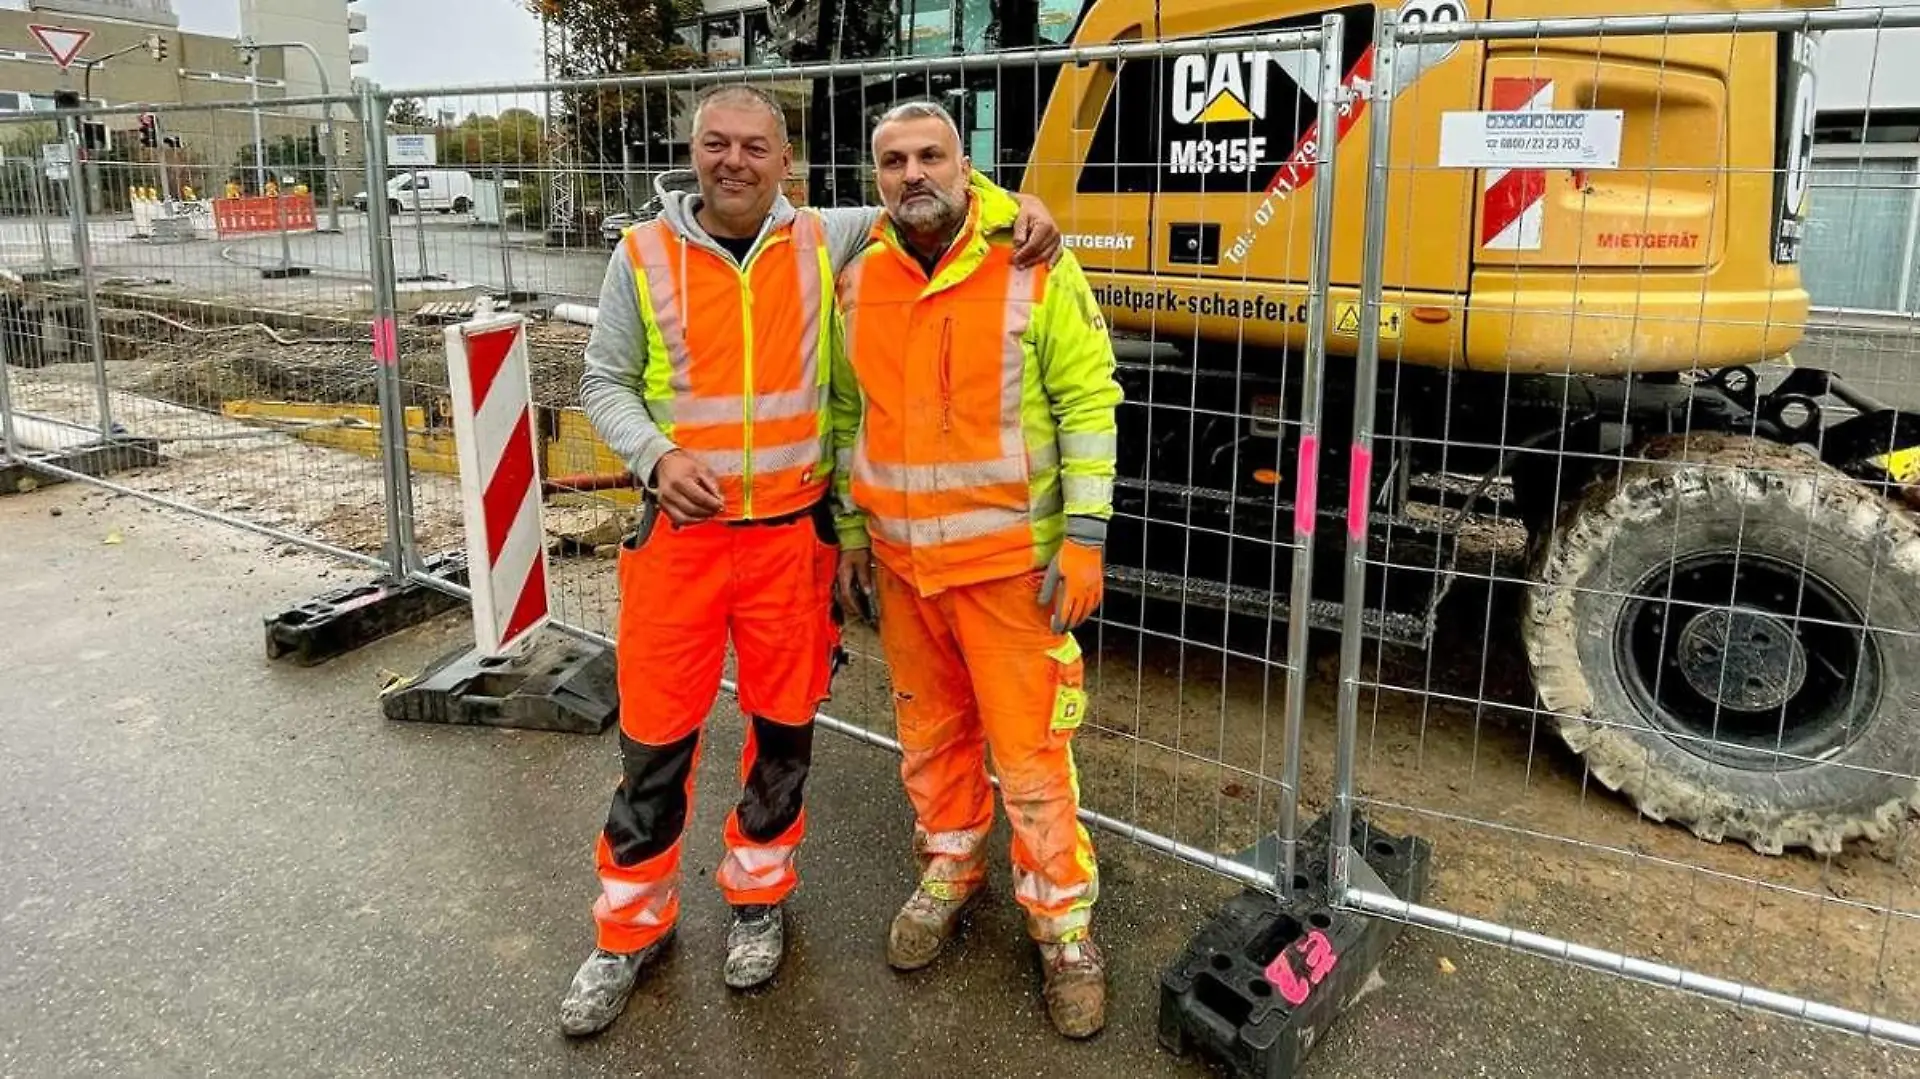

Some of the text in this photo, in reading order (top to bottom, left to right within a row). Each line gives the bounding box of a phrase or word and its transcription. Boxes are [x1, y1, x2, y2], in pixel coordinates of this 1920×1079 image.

[1172, 51, 1269, 124] CAT
[1170, 137, 1267, 174] M315F
[1060, 232, 1135, 249] IETGERÄT
[1597, 231, 1699, 249] MIETGERÄT
[1091, 283, 1308, 324] mietpark-schaefer.d
